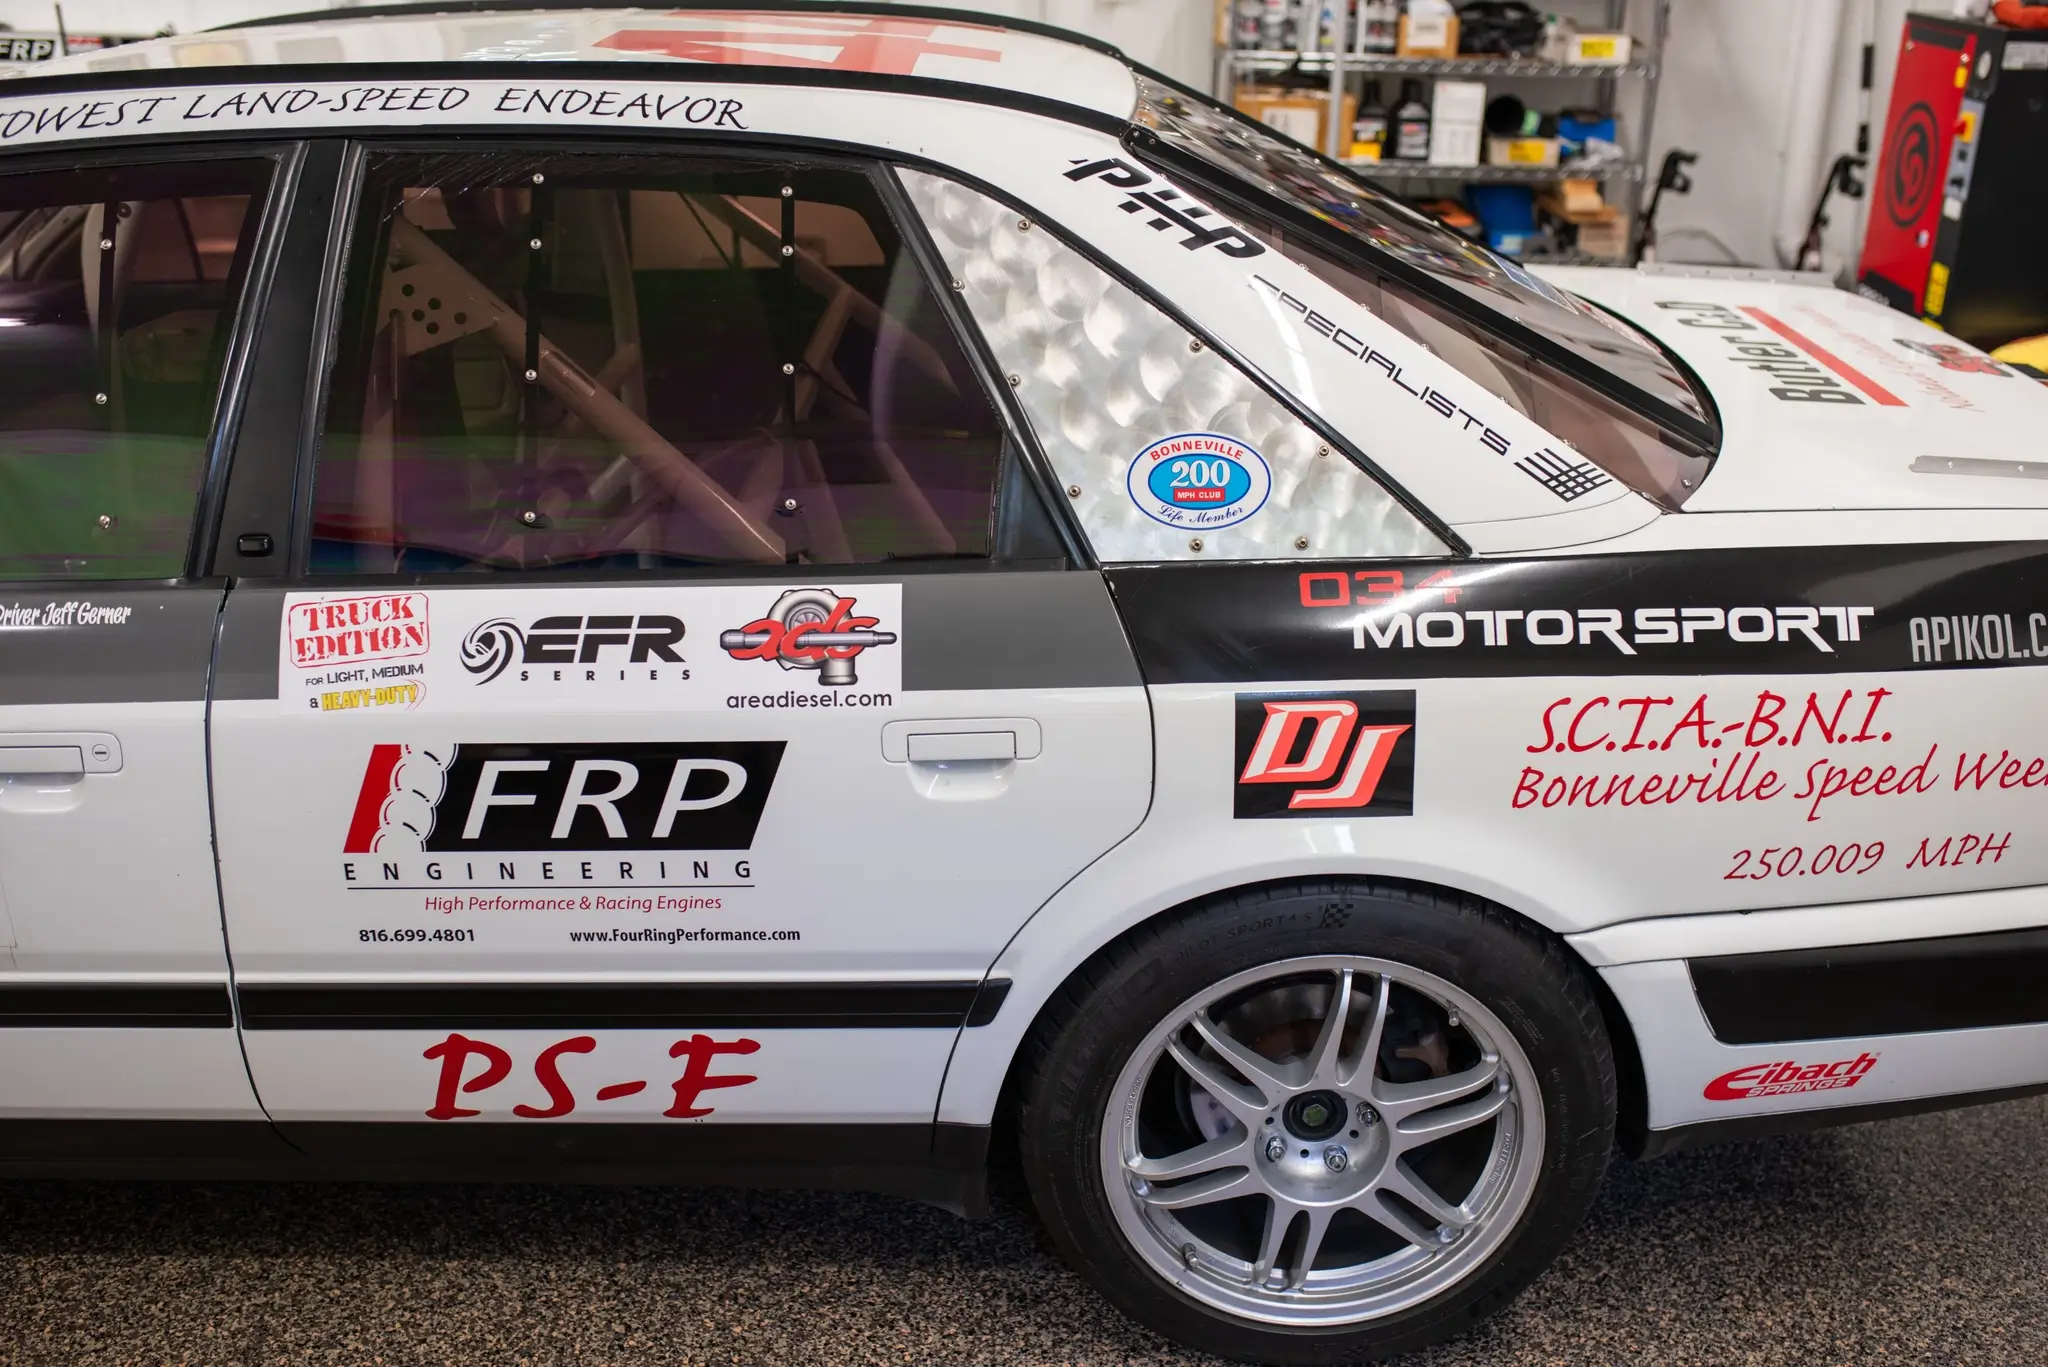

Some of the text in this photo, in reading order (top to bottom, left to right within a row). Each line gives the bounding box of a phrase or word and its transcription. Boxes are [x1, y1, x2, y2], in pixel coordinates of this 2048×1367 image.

[0, 87, 749, 139] DWEST LAND-SPEED ENDEAVOR
[1720, 335, 1867, 405] Butler
[1150, 440, 1244, 461] BONNEVILLE
[1170, 460, 1231, 487] 200
[1177, 491, 1221, 499] MPH CLUB
[1157, 505, 1245, 524] Life Member
[1300, 569, 1463, 607] 034
[42, 601, 78, 626] Jeff
[77, 601, 131, 625] Gerner
[303, 596, 414, 632] TRUCK
[295, 621, 425, 662] EDITION
[524, 614, 687, 664] EFR
[1353, 606, 1875, 655] MOTORSPORT
[306, 663, 424, 686] FOR LIGHT, MEDIUM
[520, 668, 691, 682] SERIES
[310, 684, 419, 711] & HEAVY-DUTY
[726, 690, 892, 709] areadiesel.com
[1238, 700, 1413, 809] DJ
[1511, 743, 2048, 822] Bonneville Speed Wee
[461, 758, 749, 840] FRP
[1723, 832, 2012, 881] 250.009 MPH
[343, 860, 751, 881] ENGINEERING
[424, 895, 722, 915] High Performance & Racing Engines
[359, 928, 476, 943] 816.699.4801
[570, 927, 801, 945] www.FourRingPerformance.com
[1703, 1052, 1878, 1101] Eibach
[1745, 1077, 1851, 1097] SPRINGS
